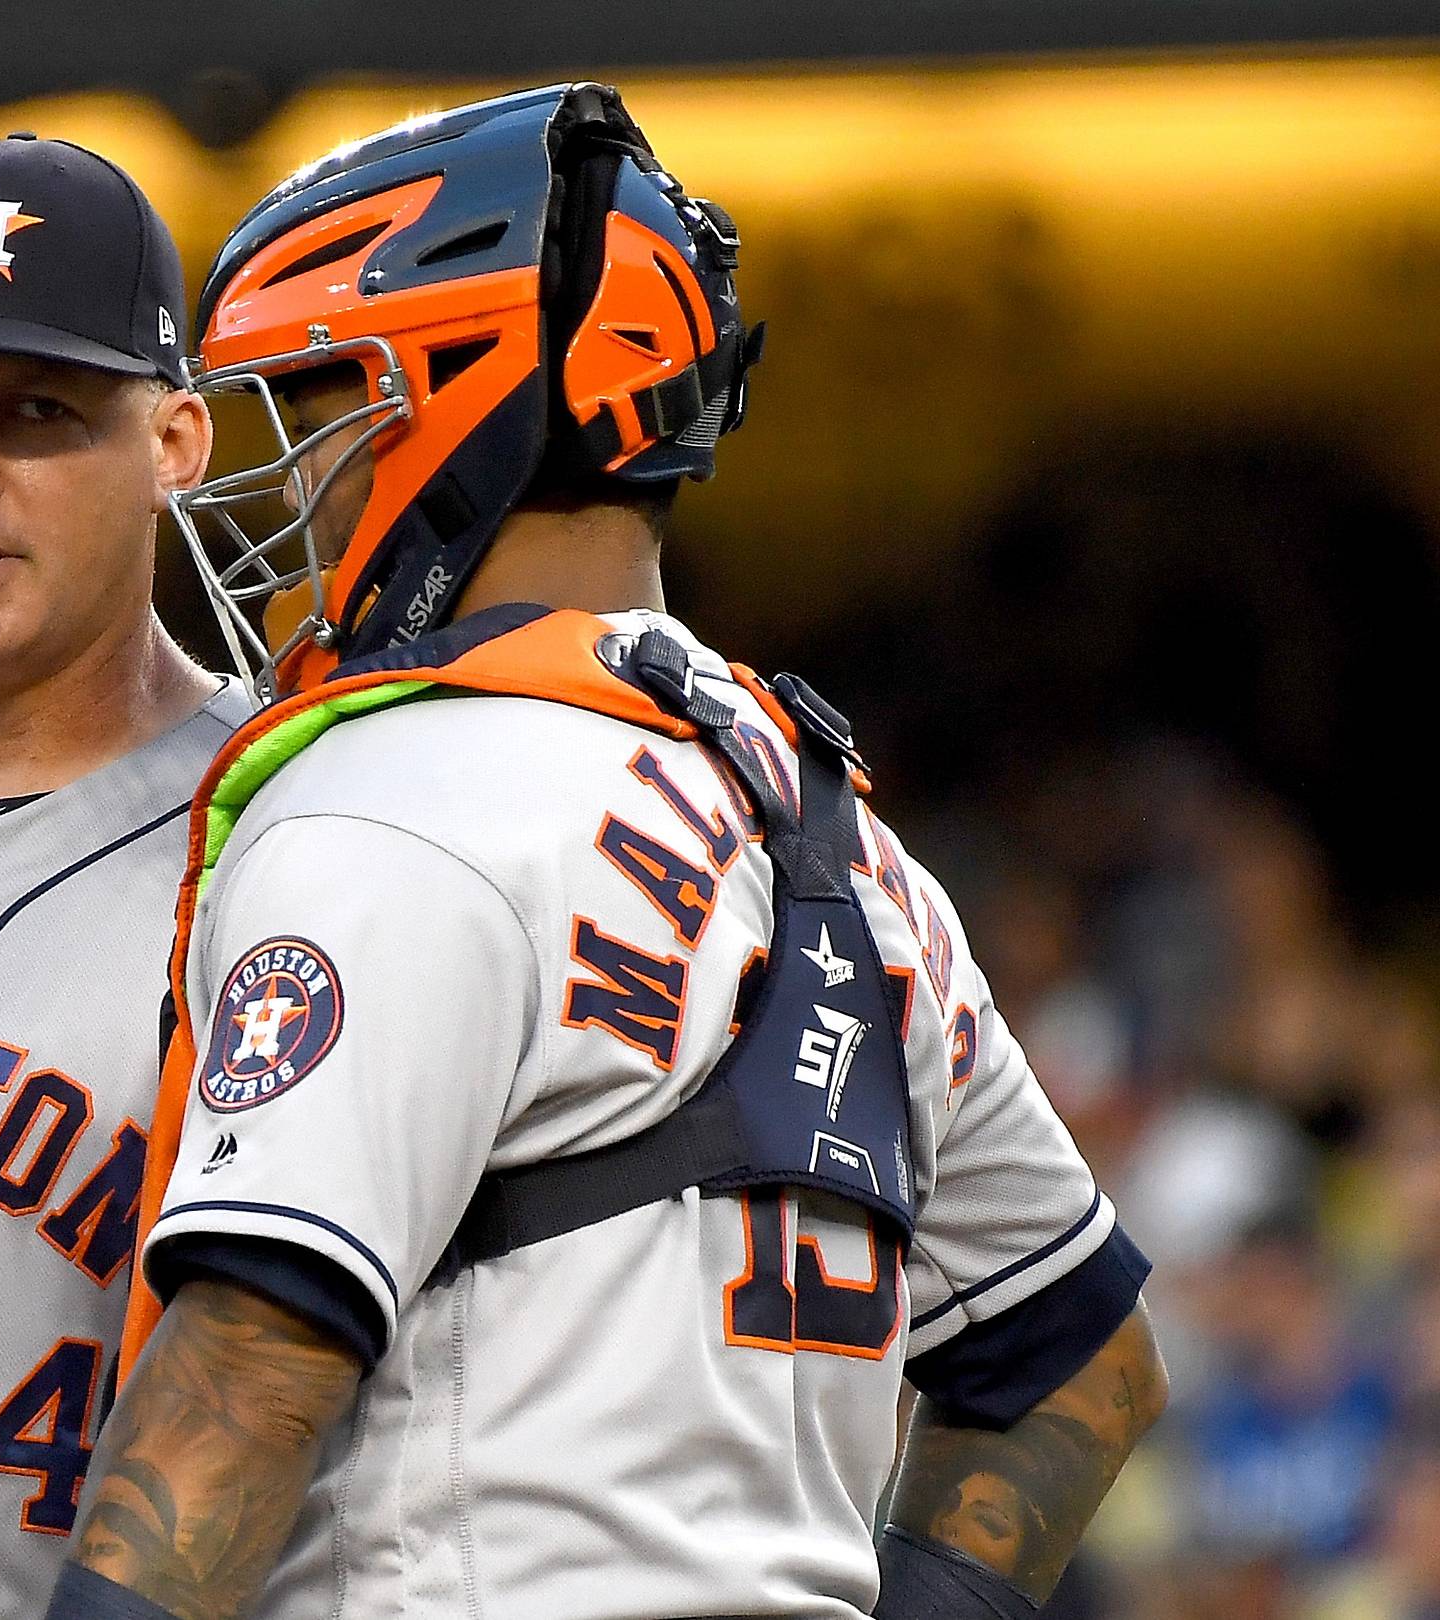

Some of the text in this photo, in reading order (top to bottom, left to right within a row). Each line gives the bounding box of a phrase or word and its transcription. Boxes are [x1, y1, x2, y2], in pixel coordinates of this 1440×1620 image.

[388, 565, 454, 650] L-STAR
[227, 948, 330, 1004] HOUSTON
[207, 1060, 296, 1102] ASTROS
